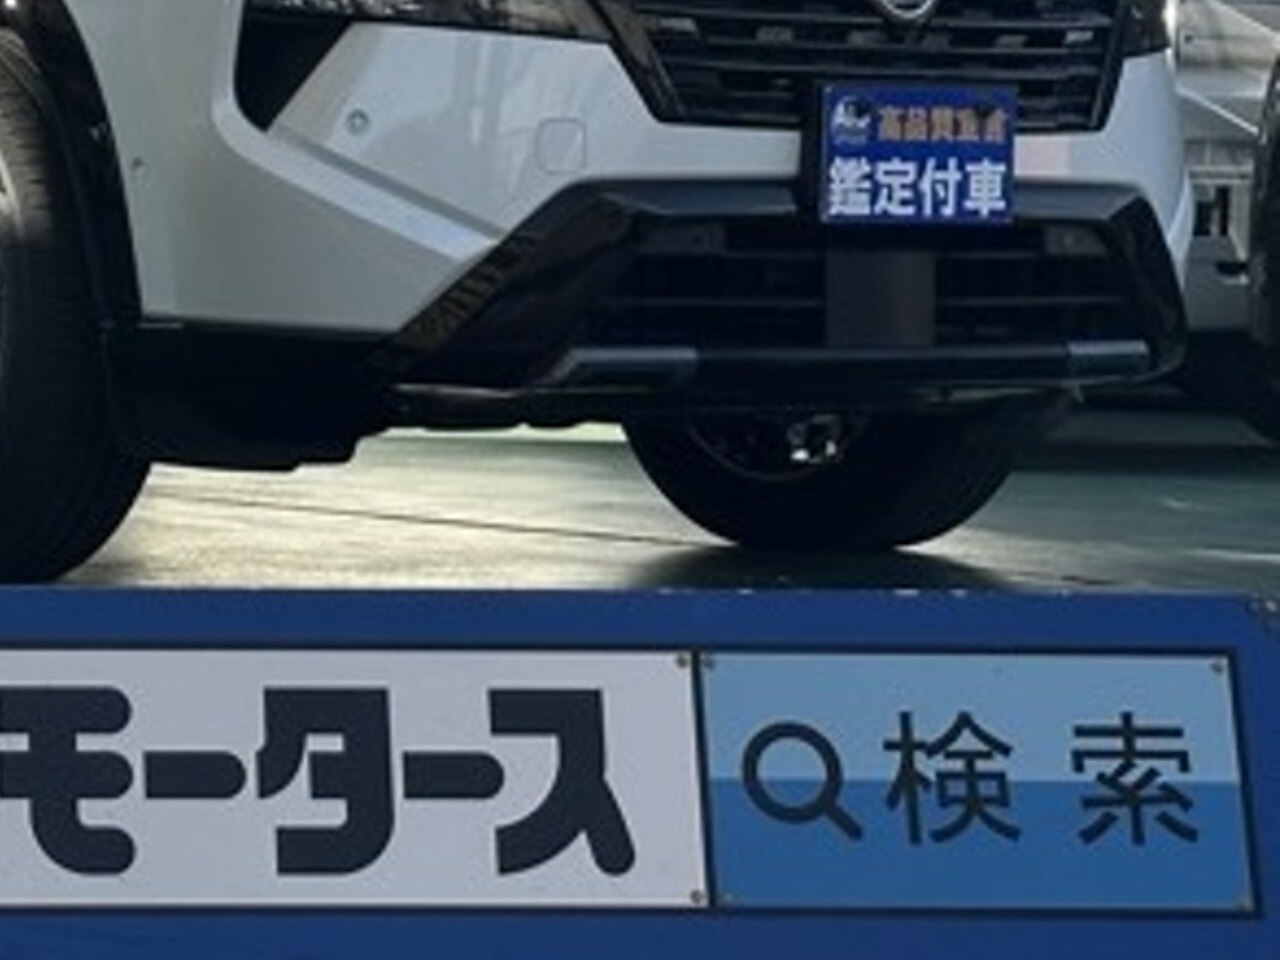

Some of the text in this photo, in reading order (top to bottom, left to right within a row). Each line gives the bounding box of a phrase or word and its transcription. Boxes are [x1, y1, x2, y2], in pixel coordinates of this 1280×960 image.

[829, 156, 1007, 217] 鑑定付車
[882, 710, 1200, 845] 検索
